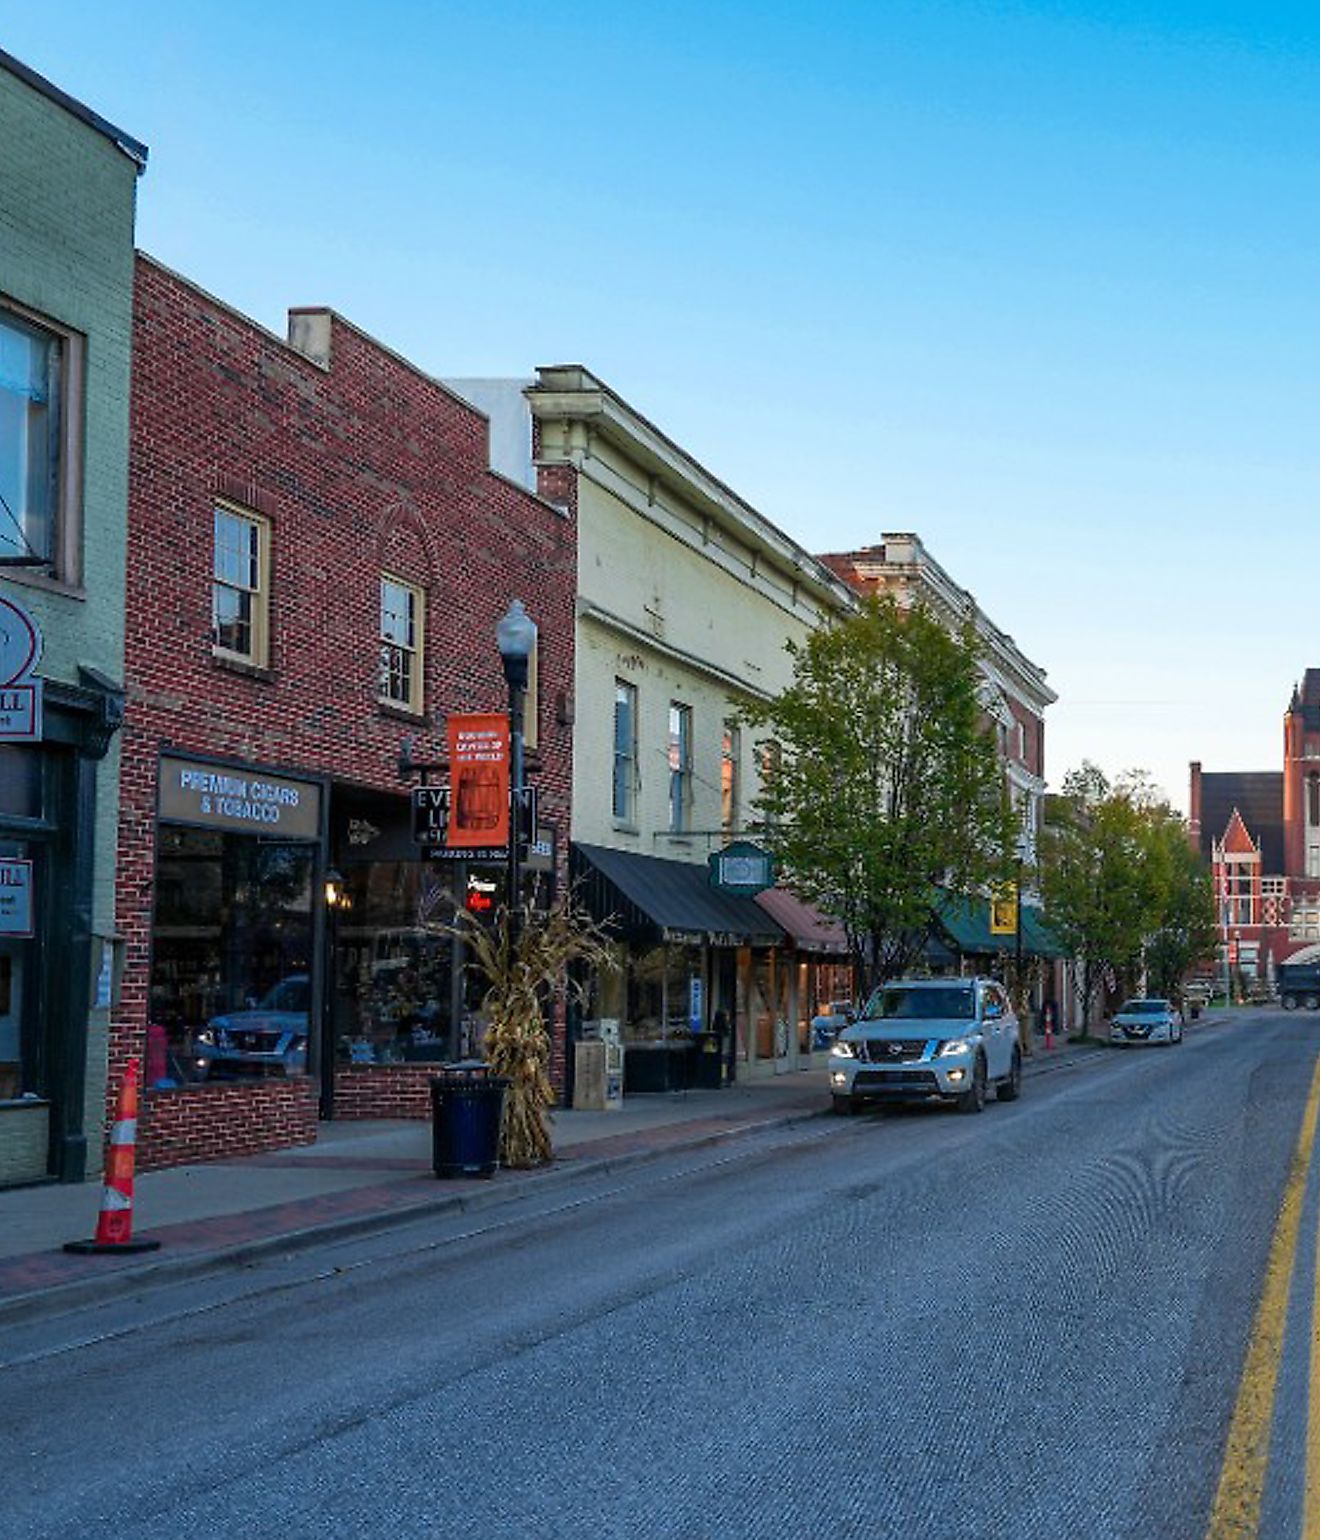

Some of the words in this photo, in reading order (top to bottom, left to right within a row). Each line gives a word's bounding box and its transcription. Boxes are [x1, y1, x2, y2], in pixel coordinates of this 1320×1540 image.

[181, 769, 246, 798] PREMIUM
[250, 781, 299, 807] CIGARS
[201, 796, 211, 814] &
[214, 797, 280, 823] TOBACCO
